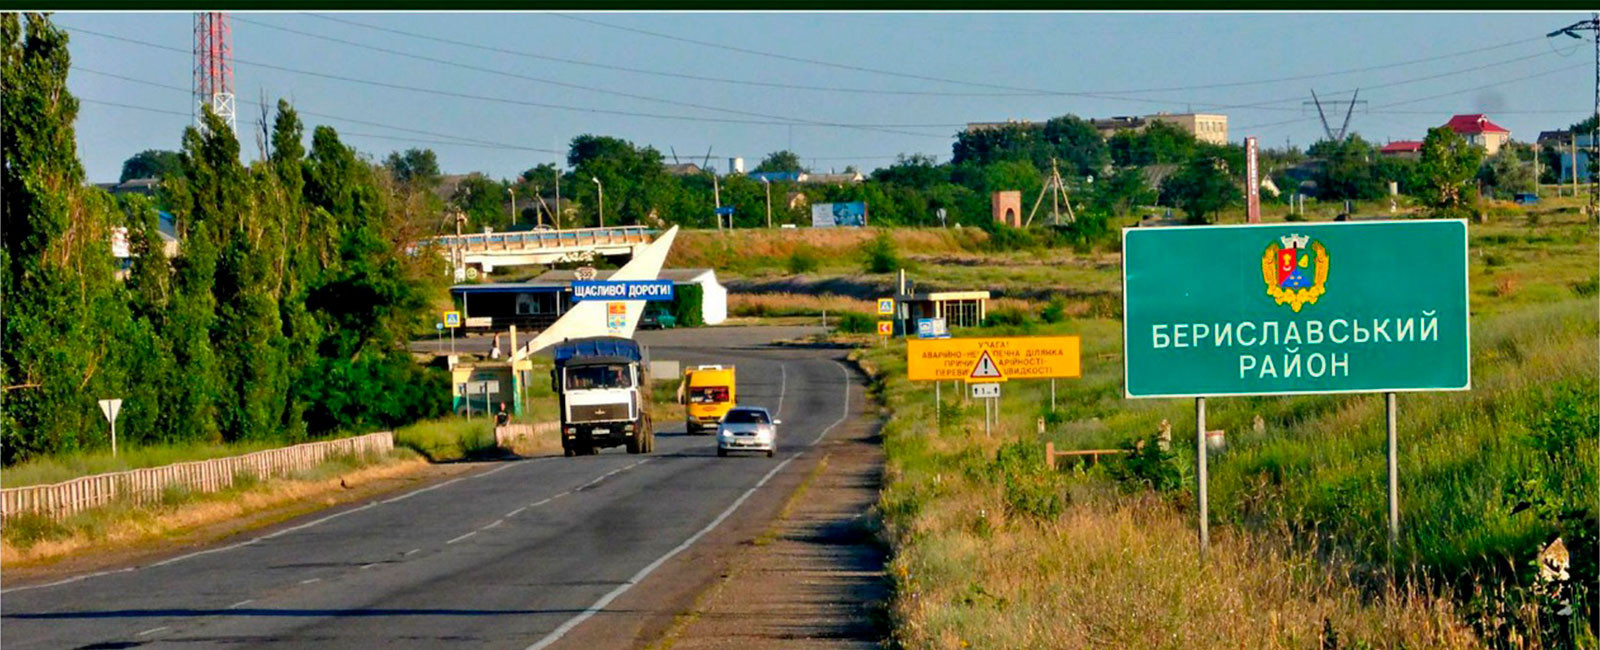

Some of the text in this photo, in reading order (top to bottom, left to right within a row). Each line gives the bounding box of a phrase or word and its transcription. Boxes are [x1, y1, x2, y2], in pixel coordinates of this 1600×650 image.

[574, 283, 671, 298] ЩАСЛИВОЇ ДОРОГИ!
[1152, 310, 1438, 348] БЕРИСЛАВСЬКИЙ
[1239, 347, 1349, 379] РАЙОН
